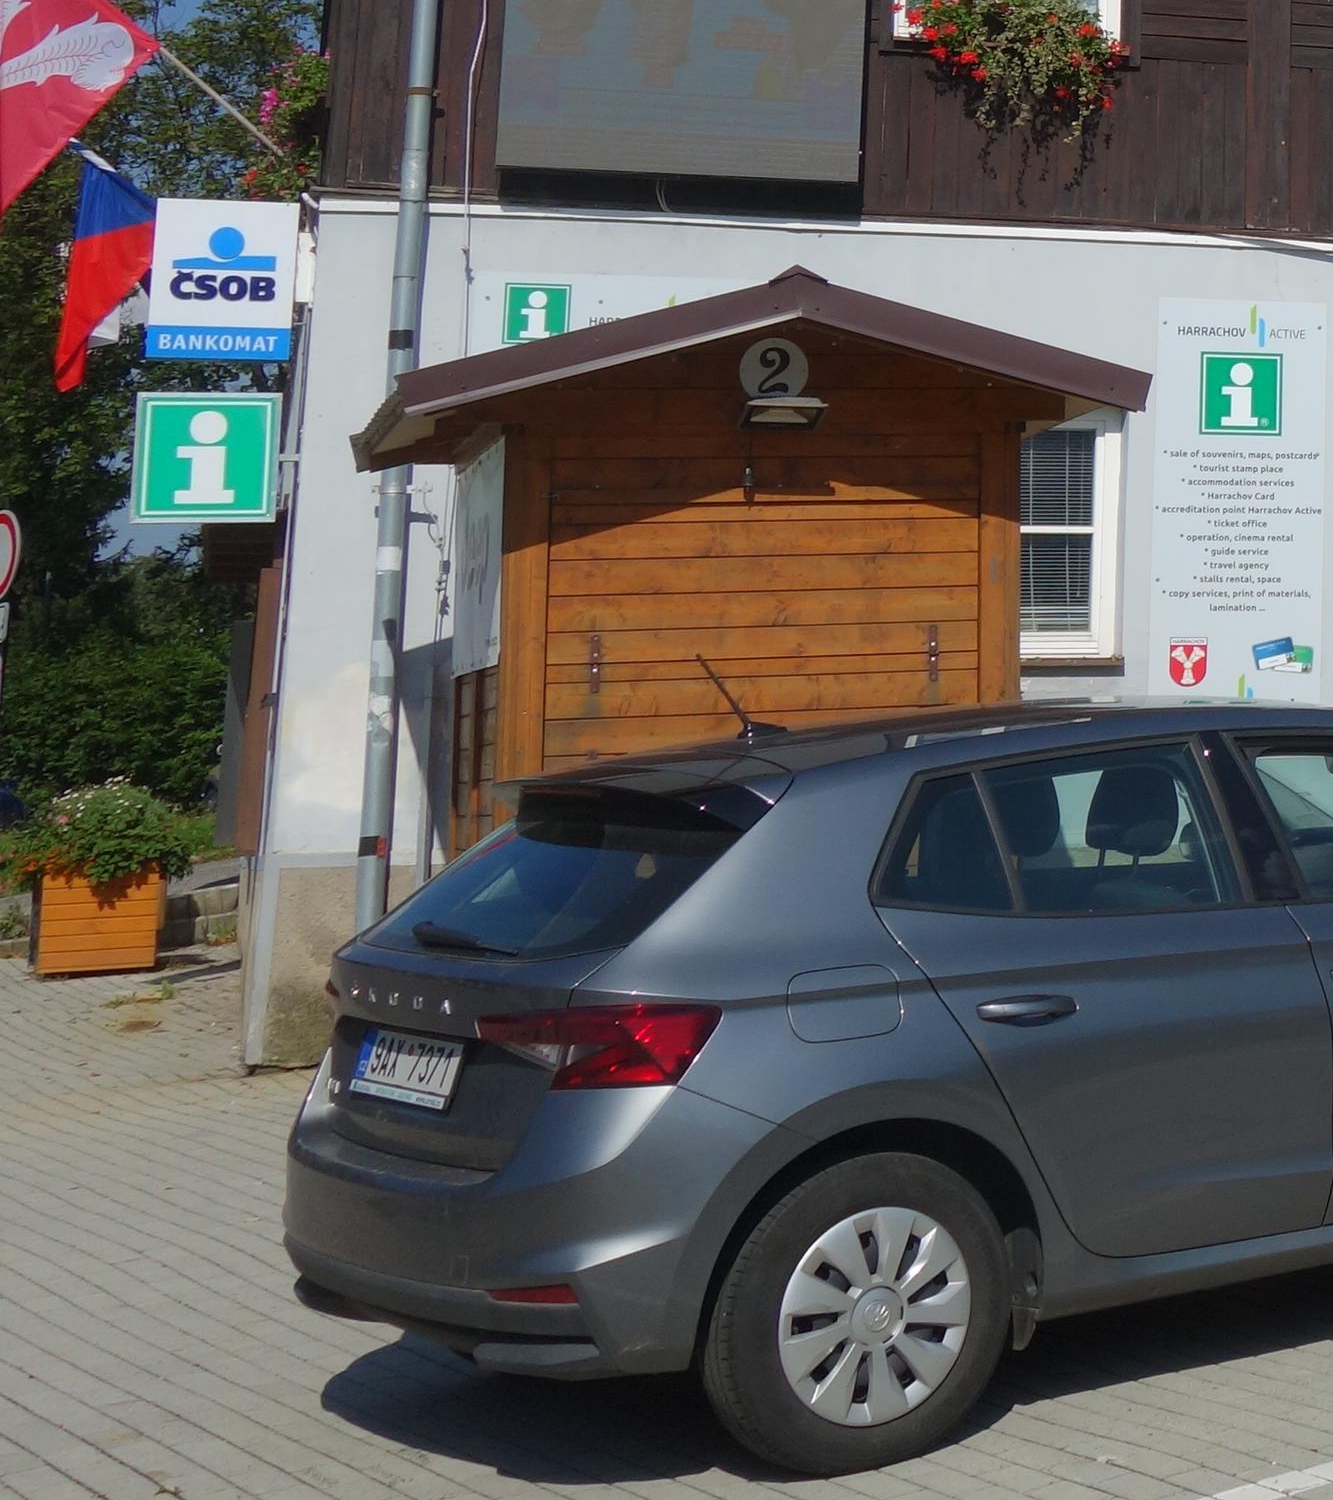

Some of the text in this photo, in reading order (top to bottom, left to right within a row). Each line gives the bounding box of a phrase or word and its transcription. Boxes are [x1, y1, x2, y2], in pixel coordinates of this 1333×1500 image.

[169, 269, 276, 302] ČSOB
[1177, 325, 1306, 340] HARRACHOV ACTIVE
[158, 333, 278, 352] BANKOMAT
[758, 346, 791, 394] 2
[1170, 450, 1188, 458] sale
[1190, 450, 1200, 458] of
[1202, 451, 1247, 460] souvenirs,
[1248, 452, 1274, 461] maps,
[1200, 465, 1284, 474] tourist stamp place
[1187, 478, 1295, 487] accommodation services
[1207, 492, 1275, 500] Harrachov Card
[1161, 505, 1322, 515] accreditation point Harrachov Active
[1213, 519, 1268, 528] ticket office
[1186, 533, 1294, 543] operation, cinema rental
[1210, 547, 1269, 557] guide service
[1209, 561, 1270, 571] travel agency
[1200, 575, 1282, 584] stalls rental, space
[1168, 589, 1311, 599] copy services, print of materials,
[1209, 603, 1257, 612] lamination
[370, 1036, 406, 1079] 9AX
